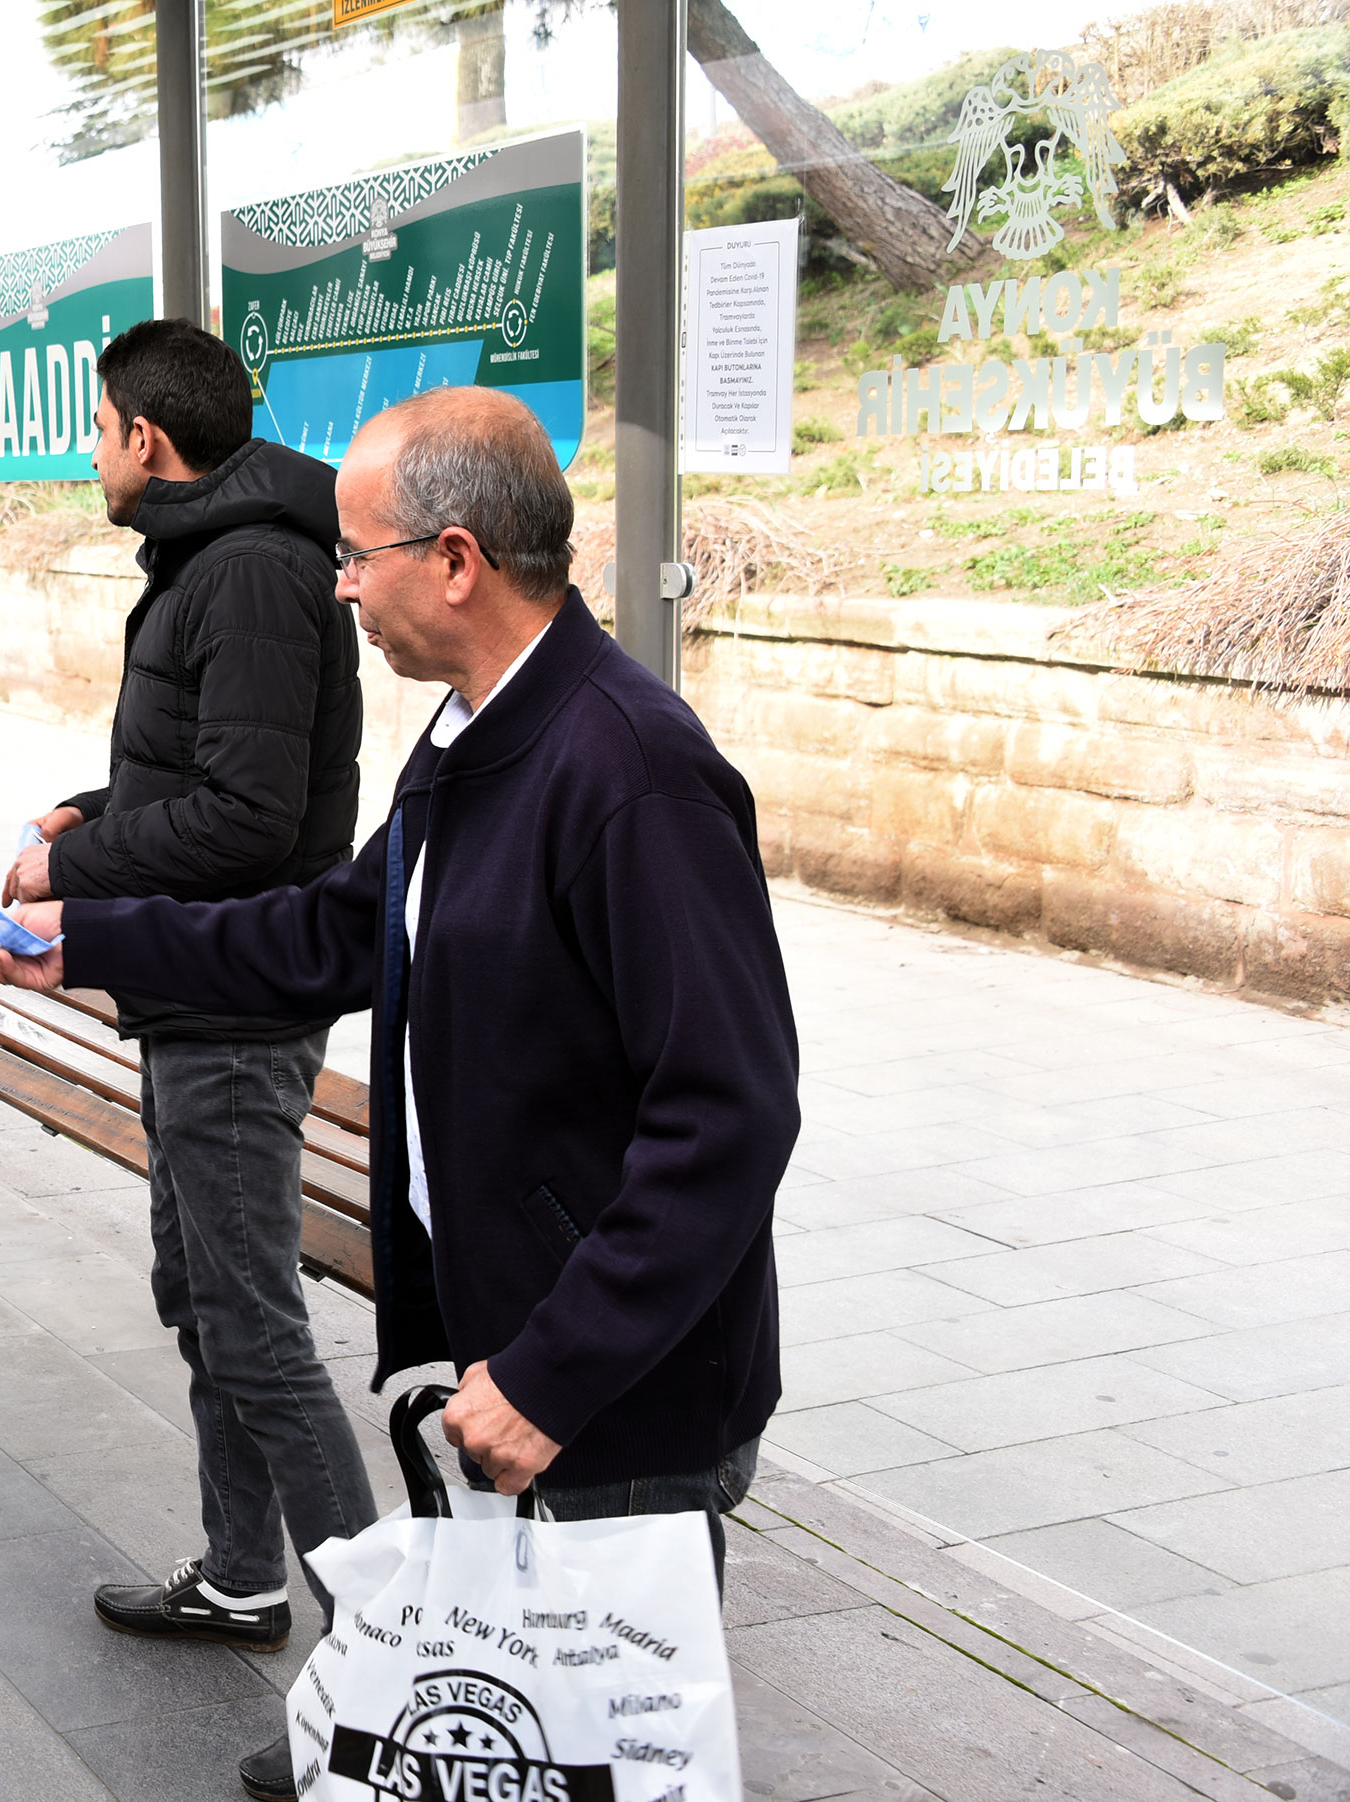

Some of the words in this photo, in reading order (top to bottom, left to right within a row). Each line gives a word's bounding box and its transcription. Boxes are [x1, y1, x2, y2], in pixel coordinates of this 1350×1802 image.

[727, 240, 752, 250] DUYURU
[416, 1640, 456, 1658] sas
[444, 1605, 496, 1640] New
[498, 1627, 540, 1669] York
[598, 1612, 678, 1661] Madrid
[406, 1684, 442, 1716] LAS
[446, 1681, 524, 1724] VEGAS
[608, 1692, 682, 1719] Milano
[368, 1740, 423, 1800] LAS
[435, 1758, 571, 1802] VEGAS
[610, 1738, 695, 1772] Sidney
[296, 1758, 322, 1797] ondra
